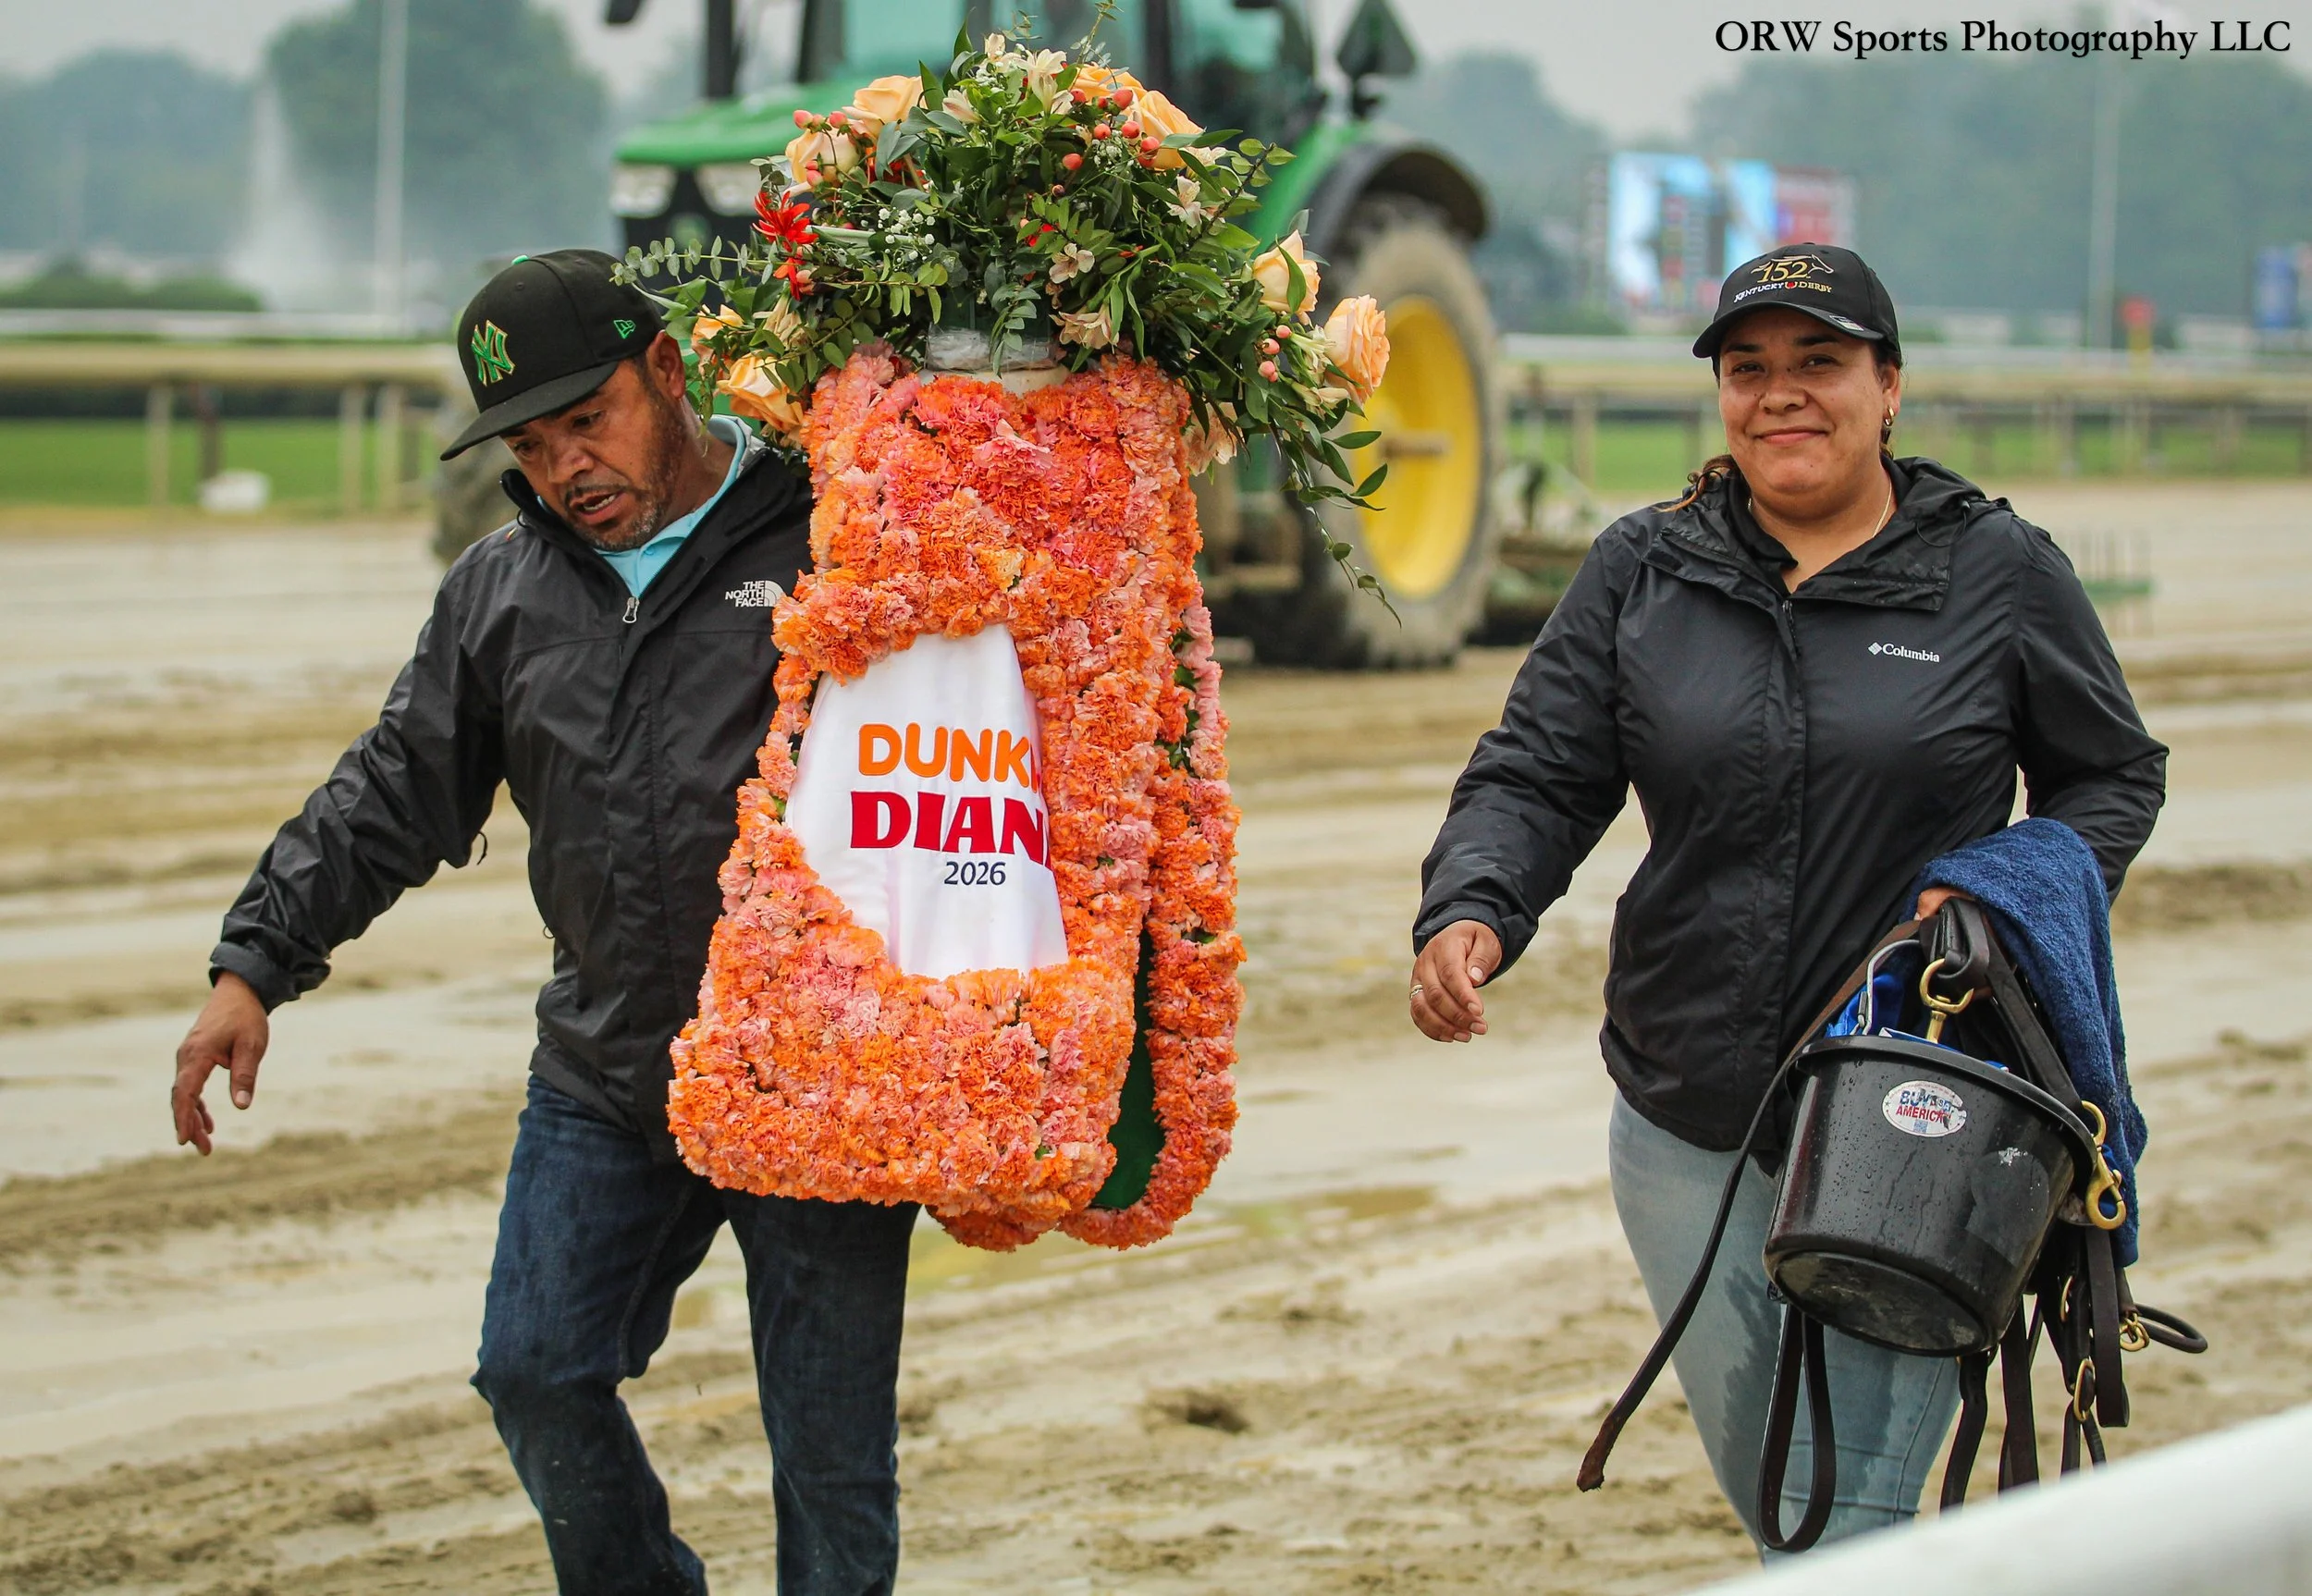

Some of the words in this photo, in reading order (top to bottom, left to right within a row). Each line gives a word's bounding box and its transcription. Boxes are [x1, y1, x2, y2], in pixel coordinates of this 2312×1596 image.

[1757, 260, 1812, 283] 152
[1733, 281, 1785, 303] KENTUCKY
[1797, 281, 1833, 294] DERBY
[725, 589, 765, 600] NORTH
[743, 580, 765, 590] THE
[735, 597, 765, 608] FACE
[1882, 643, 1940, 663] Columbia
[850, 791, 1051, 870] DIAN
[943, 861, 1006, 886] 2026
[1896, 1104, 1952, 1124] AMERICA
